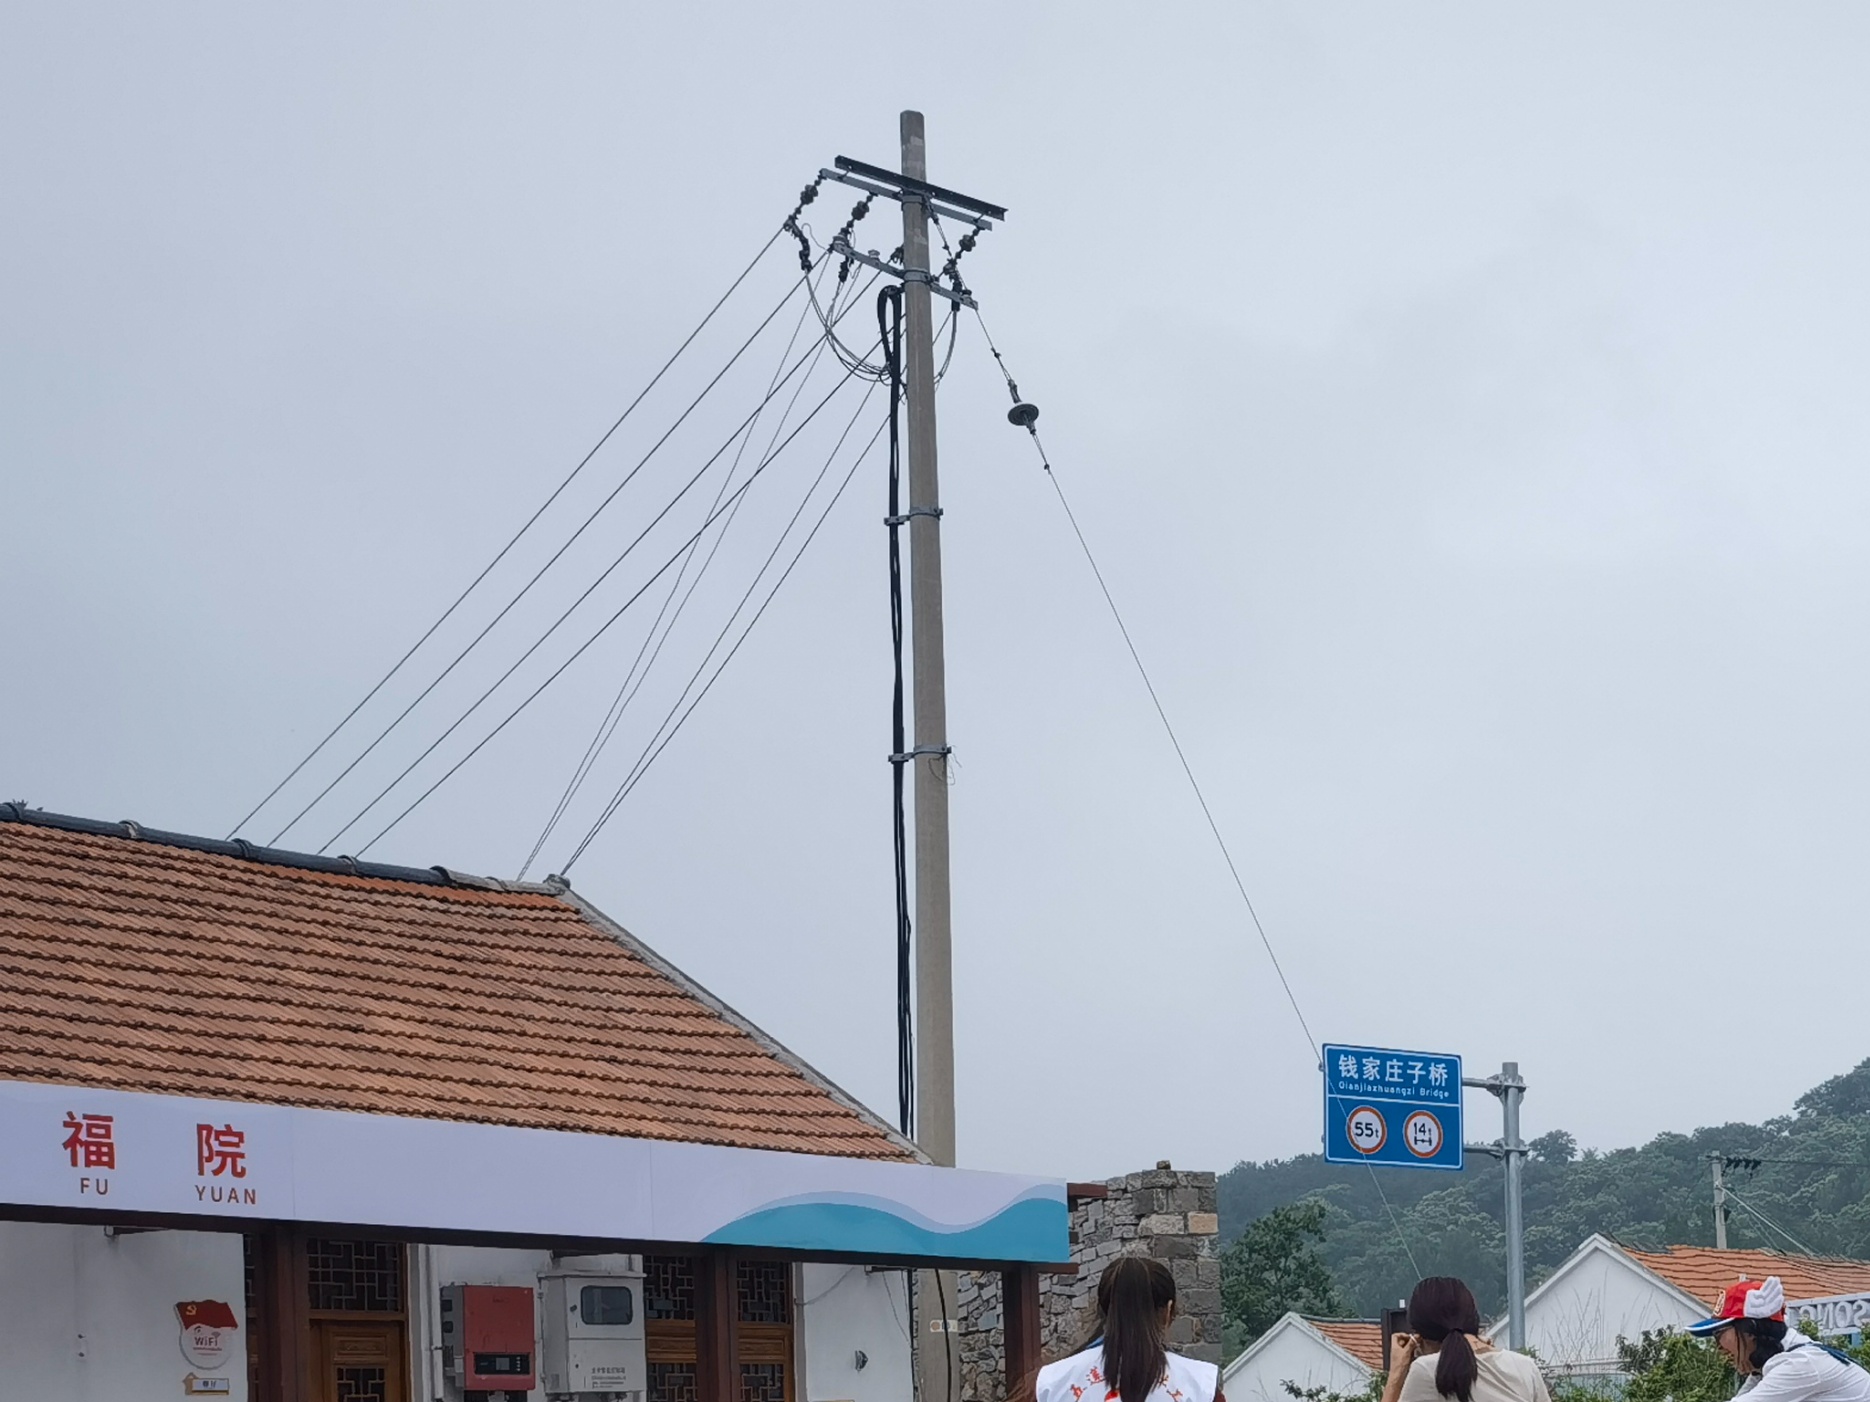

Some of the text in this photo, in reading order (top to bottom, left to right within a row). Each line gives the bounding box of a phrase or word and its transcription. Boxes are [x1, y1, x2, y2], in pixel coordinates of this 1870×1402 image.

[1338, 1054, 1448, 1087] 钱家庄子桥
[1338, 1081, 1450, 1099] Qianjiazhuangzi Bridge
[1354, 1121, 1380, 1139] 55t
[1413, 1122, 1432, 1136] 14t
[80, 1177, 257, 1205] FU YUAN
[194, 1335, 219, 1347] WiFi
